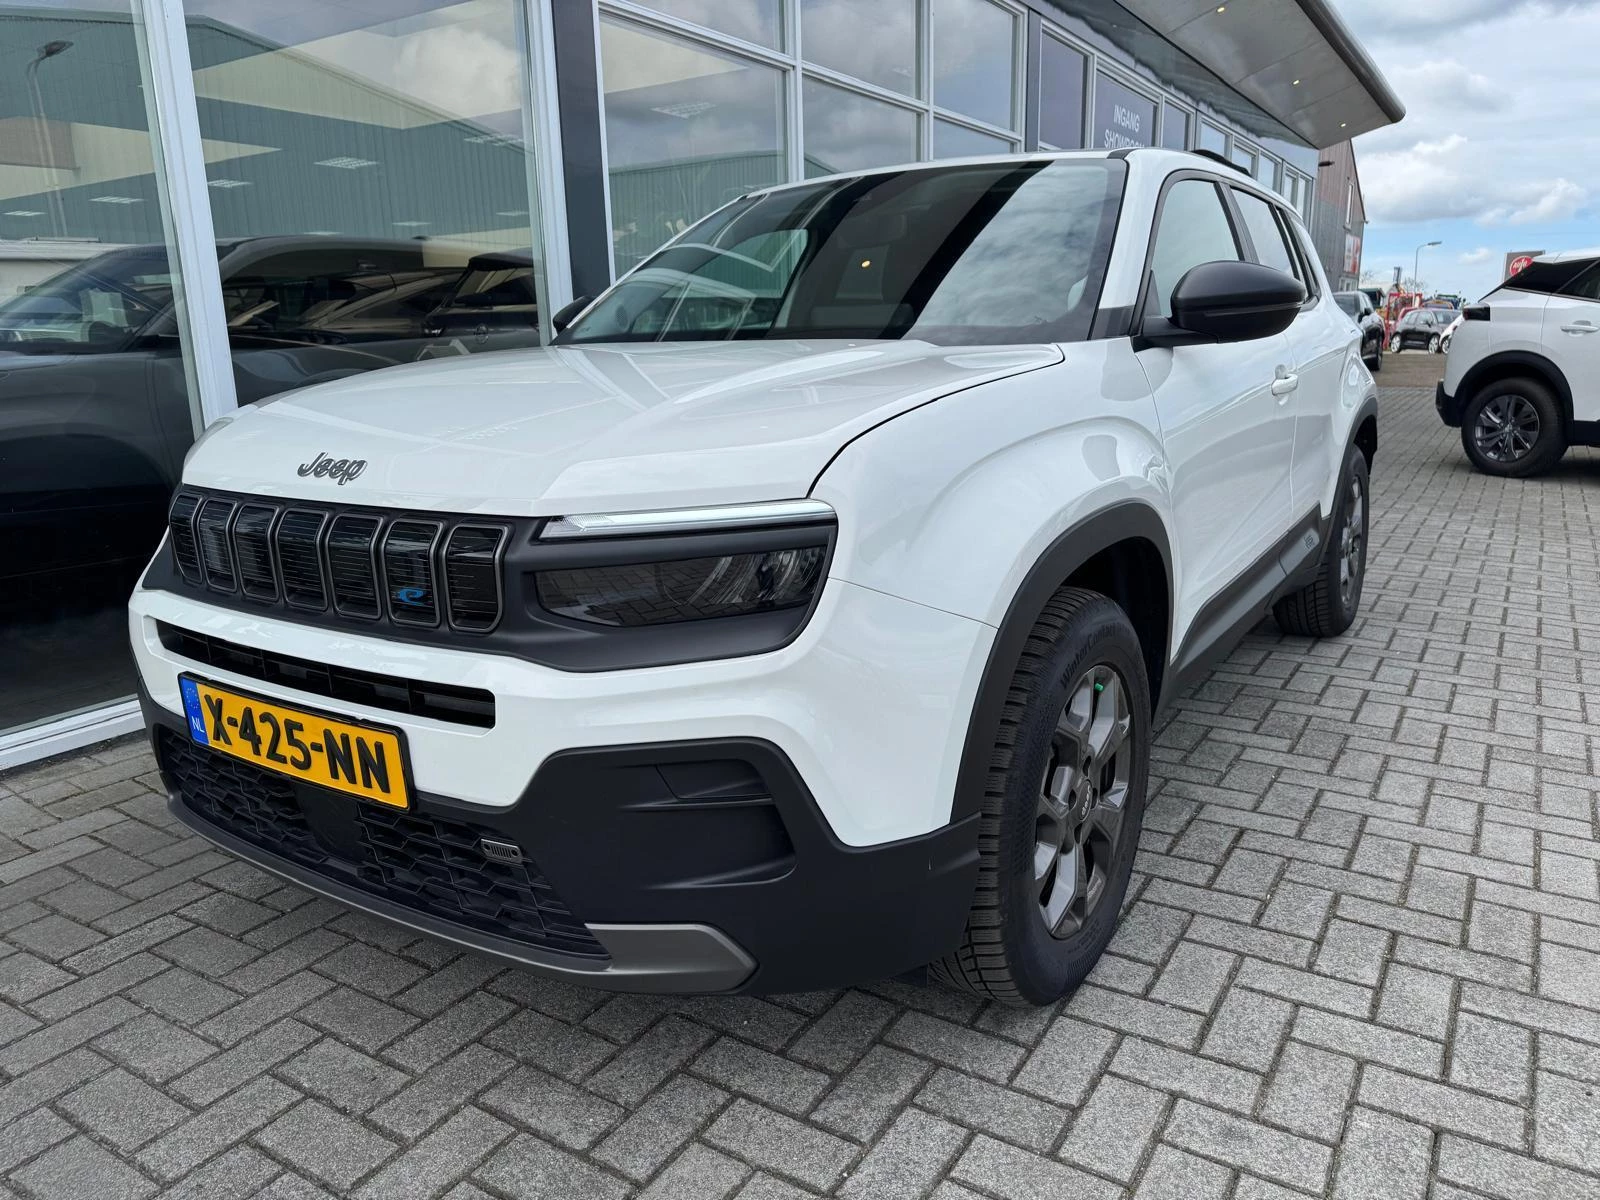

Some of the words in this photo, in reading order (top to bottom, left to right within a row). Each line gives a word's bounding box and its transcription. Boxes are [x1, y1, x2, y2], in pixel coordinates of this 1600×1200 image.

[1113, 104, 1141, 133] INGANG
[1104, 129, 1145, 148] SHOWR
[297, 451, 368, 486] Jeep
[191, 715, 206, 734] NL
[204, 694, 391, 794] X-425-NN
